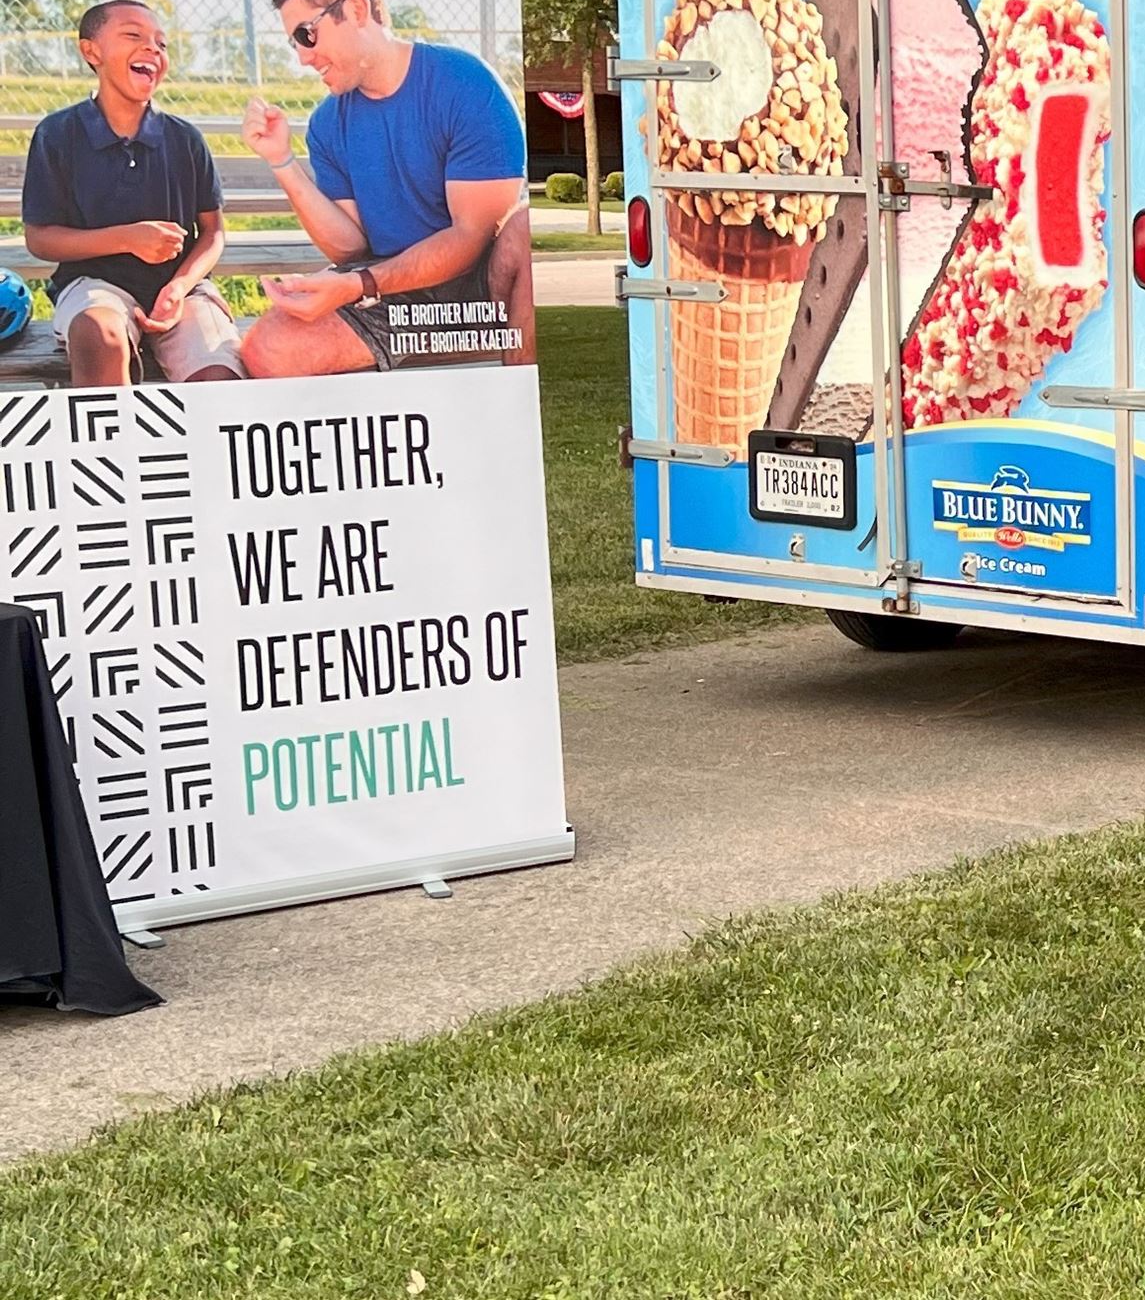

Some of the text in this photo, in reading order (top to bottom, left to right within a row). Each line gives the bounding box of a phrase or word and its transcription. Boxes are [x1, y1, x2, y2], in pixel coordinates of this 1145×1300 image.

[388, 301, 508, 326] BIG BROTHER MITCH &
[390, 328, 523, 355] LITTLE BROTHER KAEDEN
[219, 413, 444, 500] TOGETHER,
[778, 458, 818, 471] INDIANA
[764, 468, 839, 499] TR384ACC
[942, 491, 998, 521] BLUE
[998, 530, 1022, 544] Wells
[227, 519, 395, 606] WE ARE
[977, 554, 1046, 576] Ice Cream
[235, 608, 530, 712] DEFENDERS OF
[242, 717, 465, 816] POTENTIAL
